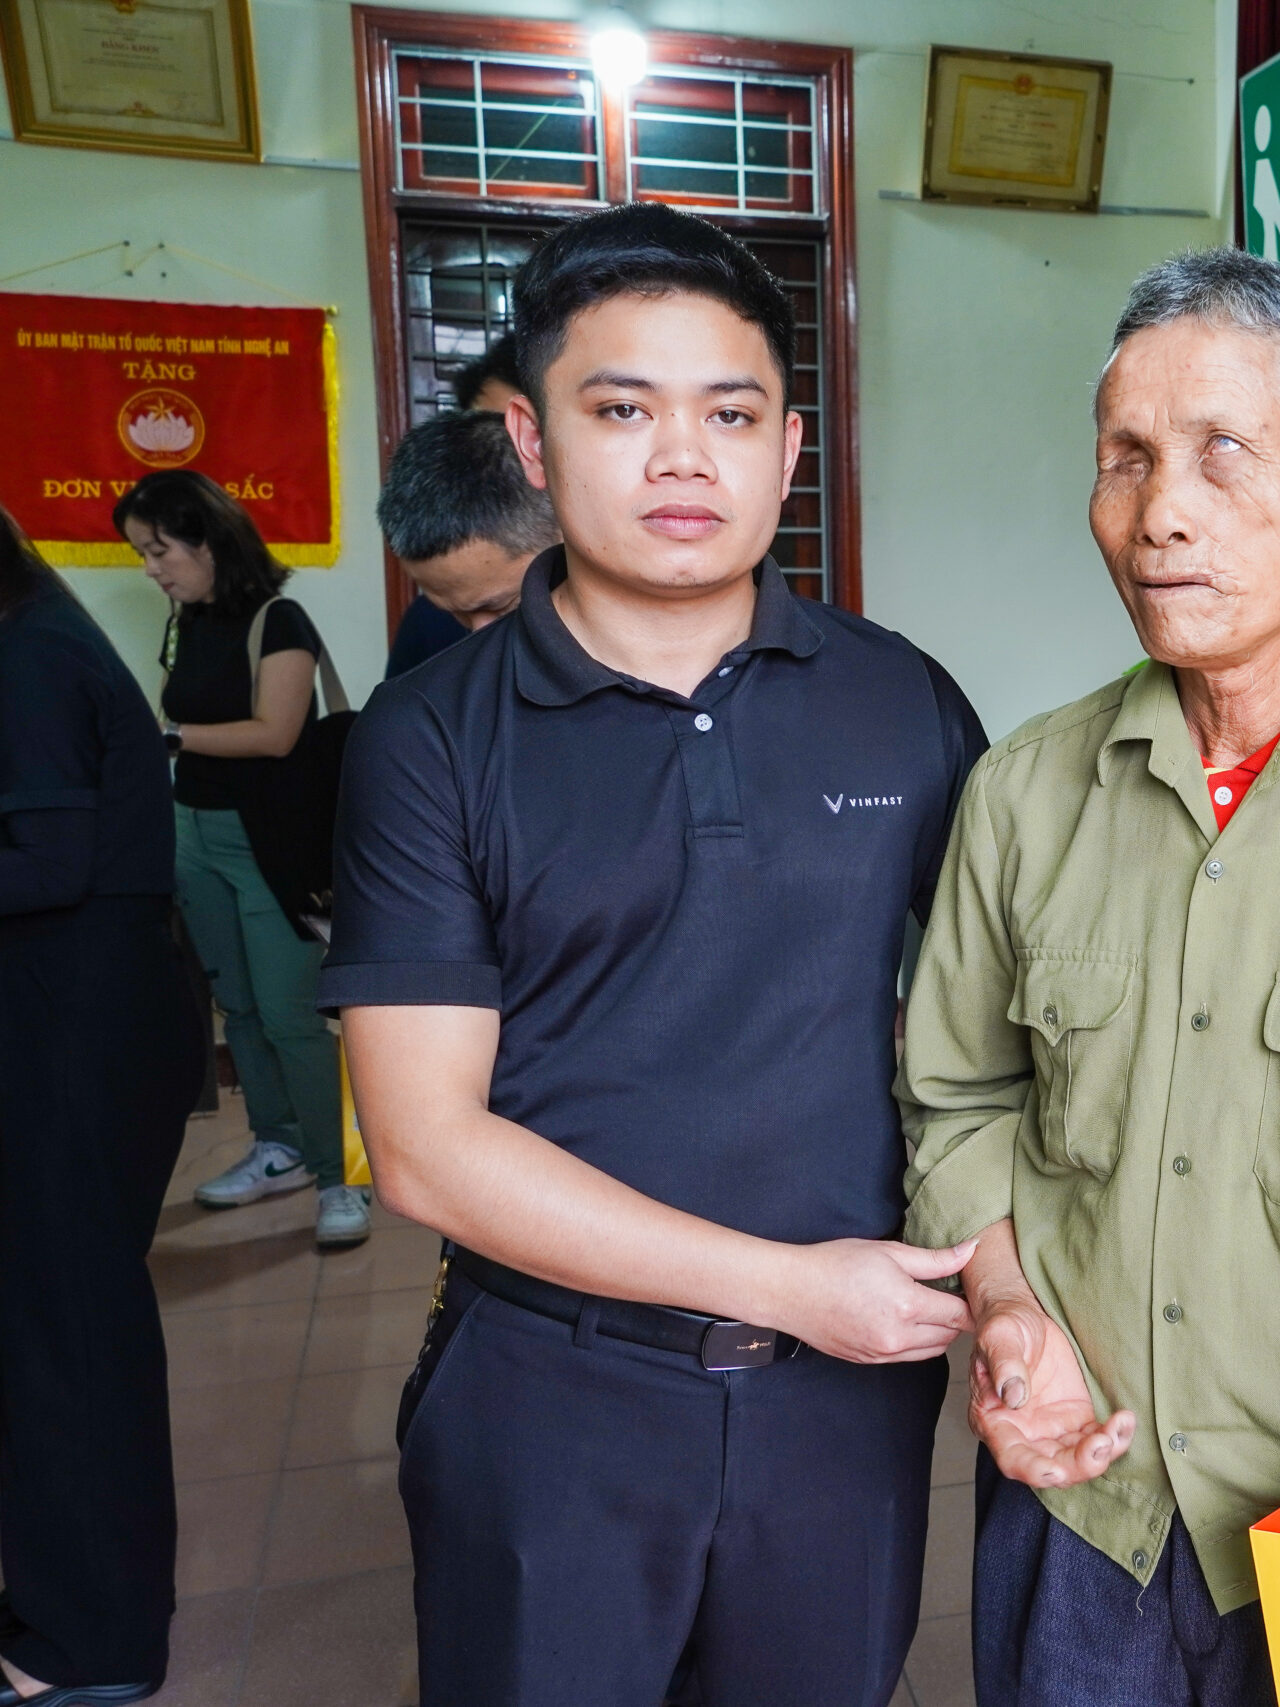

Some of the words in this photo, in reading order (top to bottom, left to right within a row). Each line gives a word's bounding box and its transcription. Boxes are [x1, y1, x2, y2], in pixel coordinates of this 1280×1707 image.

[35, 332, 59, 348] BAN
[190, 339, 215, 353] NAM
[273, 340, 289, 355] AN
[43, 478, 102, 498] ĐƠN
[225, 473, 274, 499] SẮC
[849, 796, 903, 807] VINFAST
